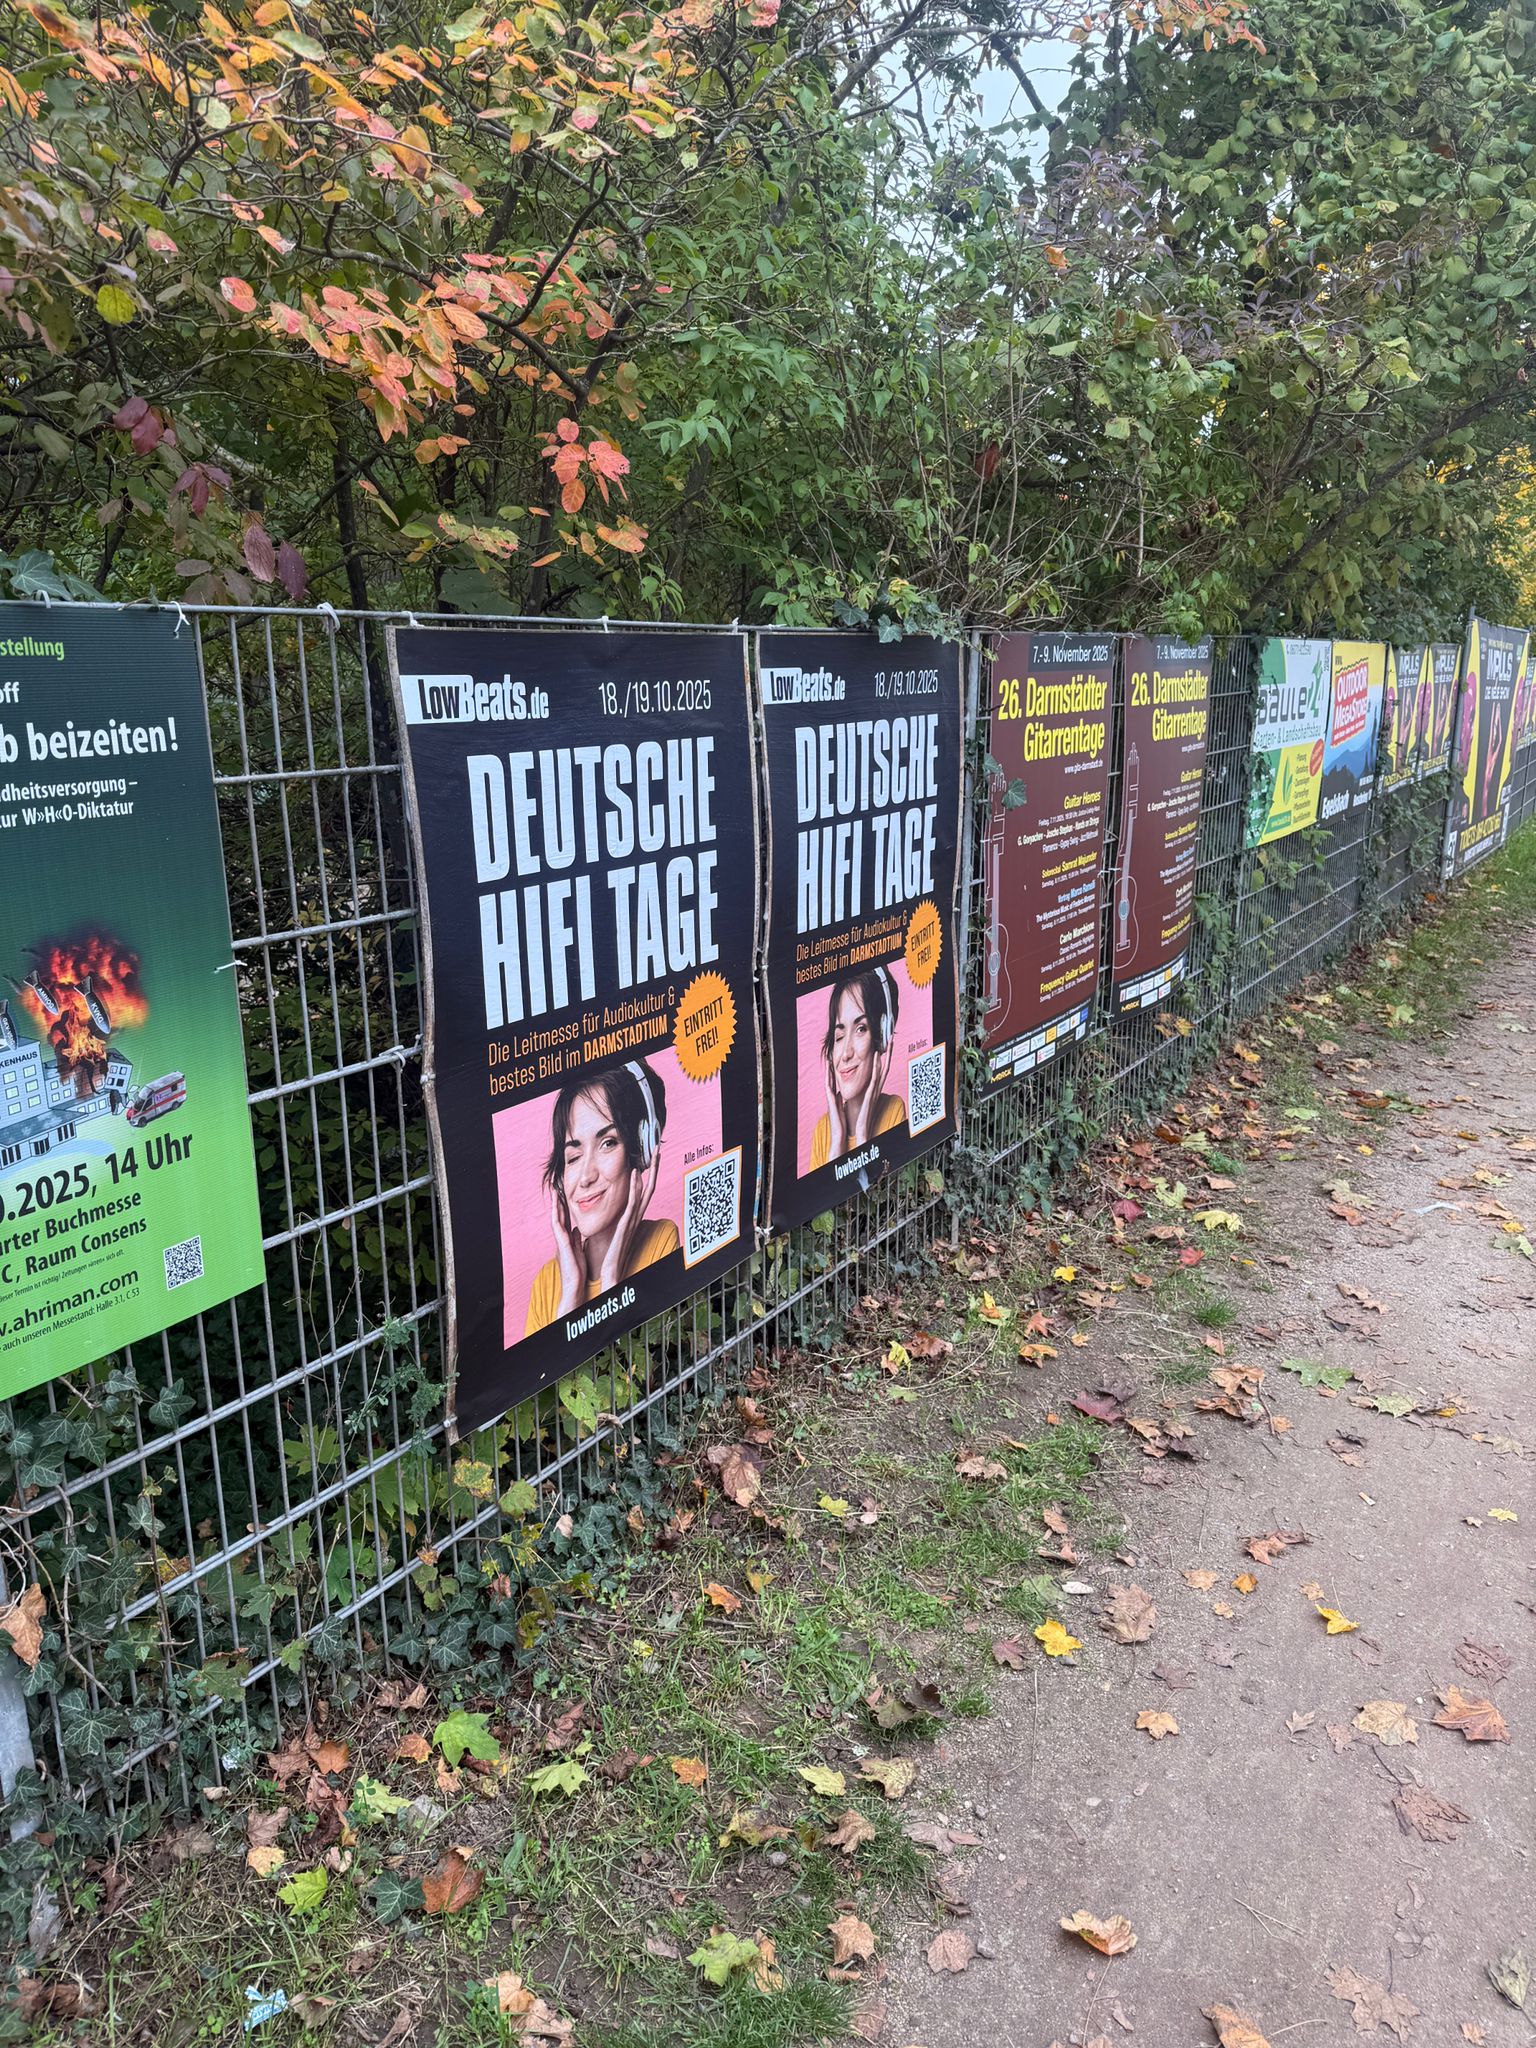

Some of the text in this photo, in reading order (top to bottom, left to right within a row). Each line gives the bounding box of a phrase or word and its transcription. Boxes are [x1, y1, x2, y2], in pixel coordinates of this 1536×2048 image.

[1033, 645, 1109, 663] 7.-9. November 2025
[1170, 645, 1197, 659] November
[418, 674, 712, 721] LowBeats.de 18./19.10.2025
[770, 666, 939, 702] LowBeats.de 18./19.10.2025
[998, 674, 1108, 720] 26. Darmstädter
[1131, 669, 1209, 706] 26. Darmstädter
[26, 717, 178, 761] beizeiten!
[1024, 718, 1105, 762] Gitarrentage
[1152, 706, 1207, 741] Gitarrentage
[0, 778, 127, 802] dheitsversorgung
[795, 713, 939, 824] DEUTSCHE
[22, 801, 134, 826] W»H«O-Diktatur
[466, 736, 717, 883] DEUTSCHE
[1064, 795, 1082, 810] Guitar
[797, 803, 938, 934] HIFI TAGE
[479, 850, 719, 1030] HIFI TAGE
[796, 943, 809, 962] Die
[810, 932, 849, 957] Leitmesse
[851, 926, 862, 943] für
[863, 914, 902, 939] Audiokultur
[796, 932, 903, 984] bestes Bild im DARMSTADTIUM
[911, 921, 935, 952] EINTRITT
[917, 944, 932, 968] FREI!
[488, 985, 676, 1067] Die Leitmesse für Audiokultur &
[684, 996, 724, 1038] EINTRITT
[489, 1014, 668, 1096] bestes Bild im DARMSTADTIUM
[696, 1026, 720, 1057] FREI!
[105, 1147, 139, 1184] 14
[145, 1133, 192, 1170] Uhr
[684, 1144, 714, 1166] Alle Infos:
[835, 1144, 880, 1181] lowbeats.de
[45, 1192, 142, 1239] Buchmesse
[2, 1218, 147, 1284] C, Raum Consens
[3, 1337, 21, 1352] auch
[22, 1326, 52, 1343] unseren
[52, 1307, 95, 1332] Messestand:
[96, 1300, 113, 1313] Halle
[566, 1286, 636, 1342] lowbeats.de
